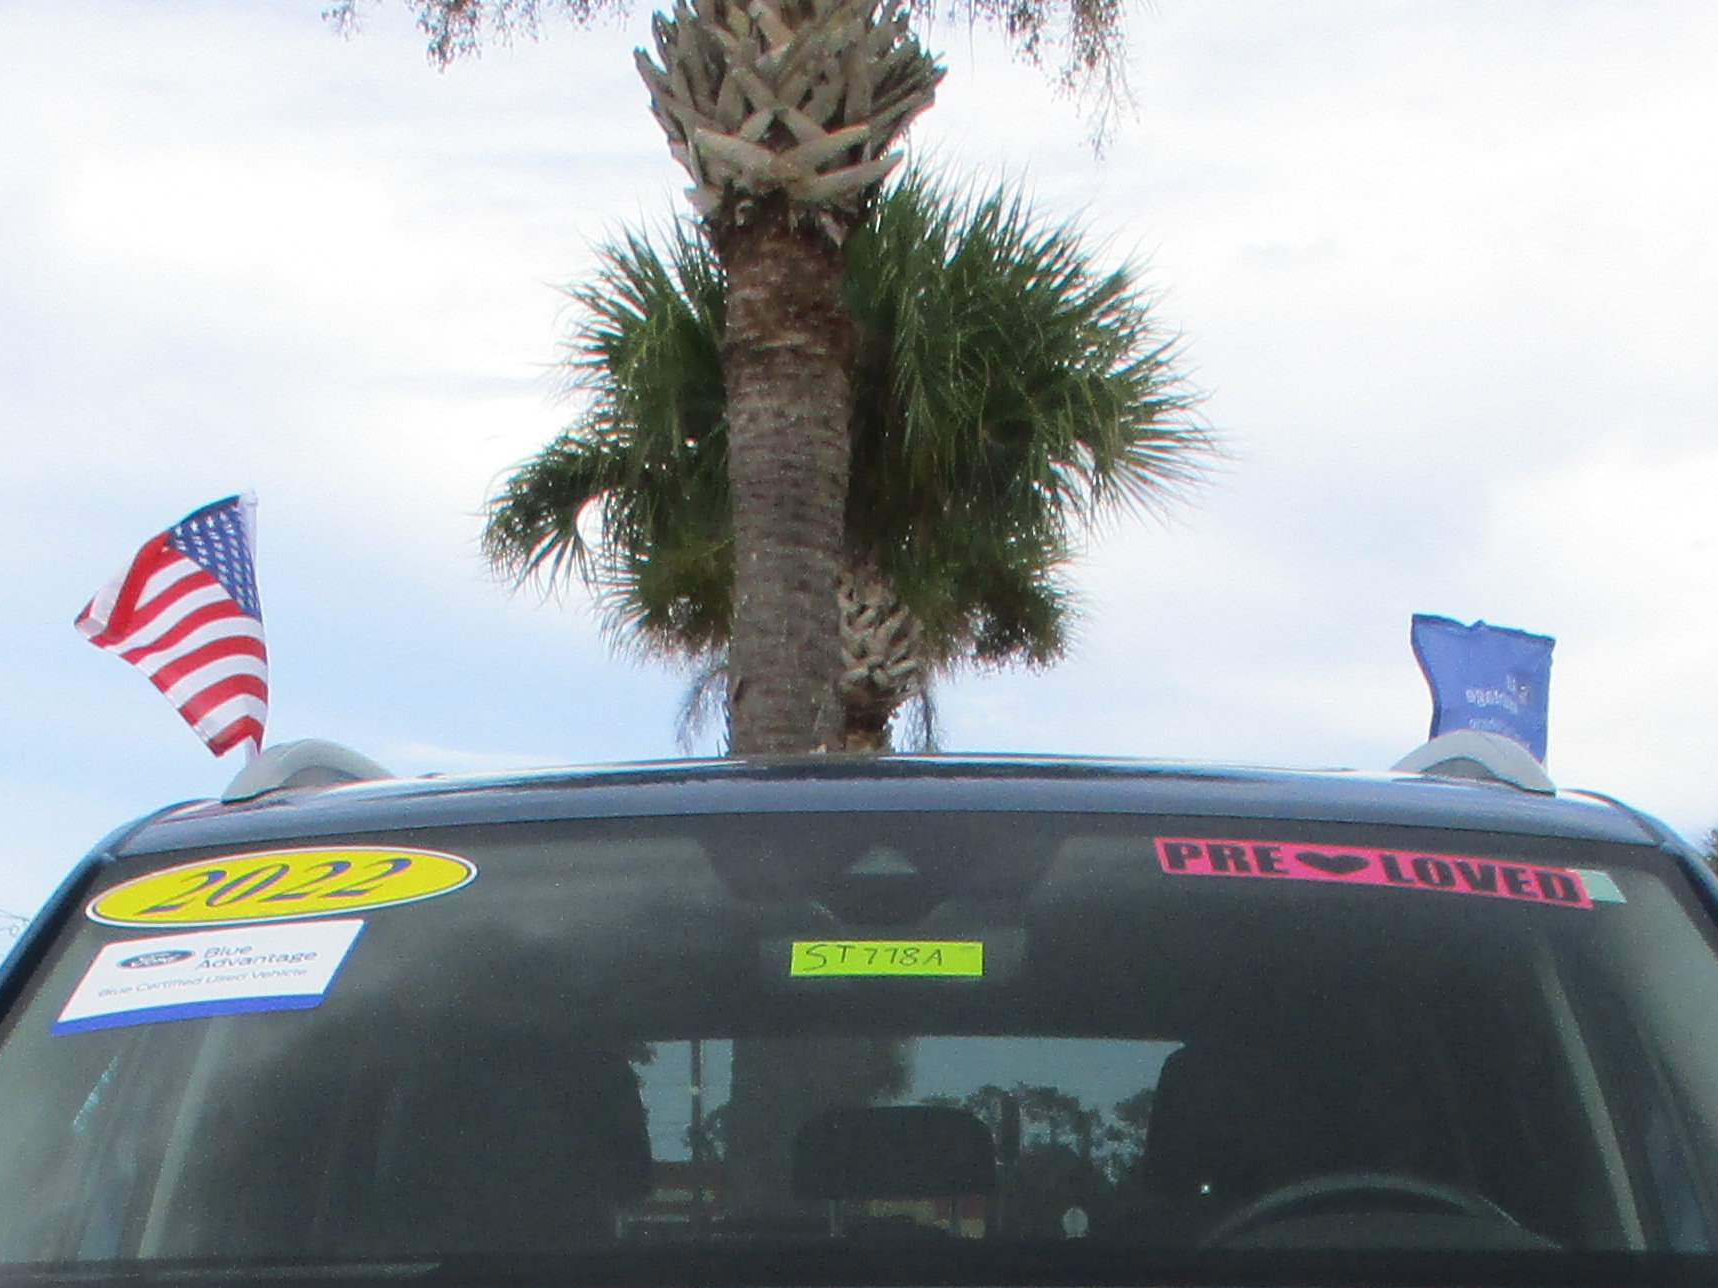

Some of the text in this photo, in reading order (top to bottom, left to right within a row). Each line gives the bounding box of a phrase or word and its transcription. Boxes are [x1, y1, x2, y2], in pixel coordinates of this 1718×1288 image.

[134, 857, 413, 916] 2022
[1162, 841, 1580, 902] PRE LOVED
[196, 951, 318, 970] Advantage
[204, 945, 253, 958] Blue
